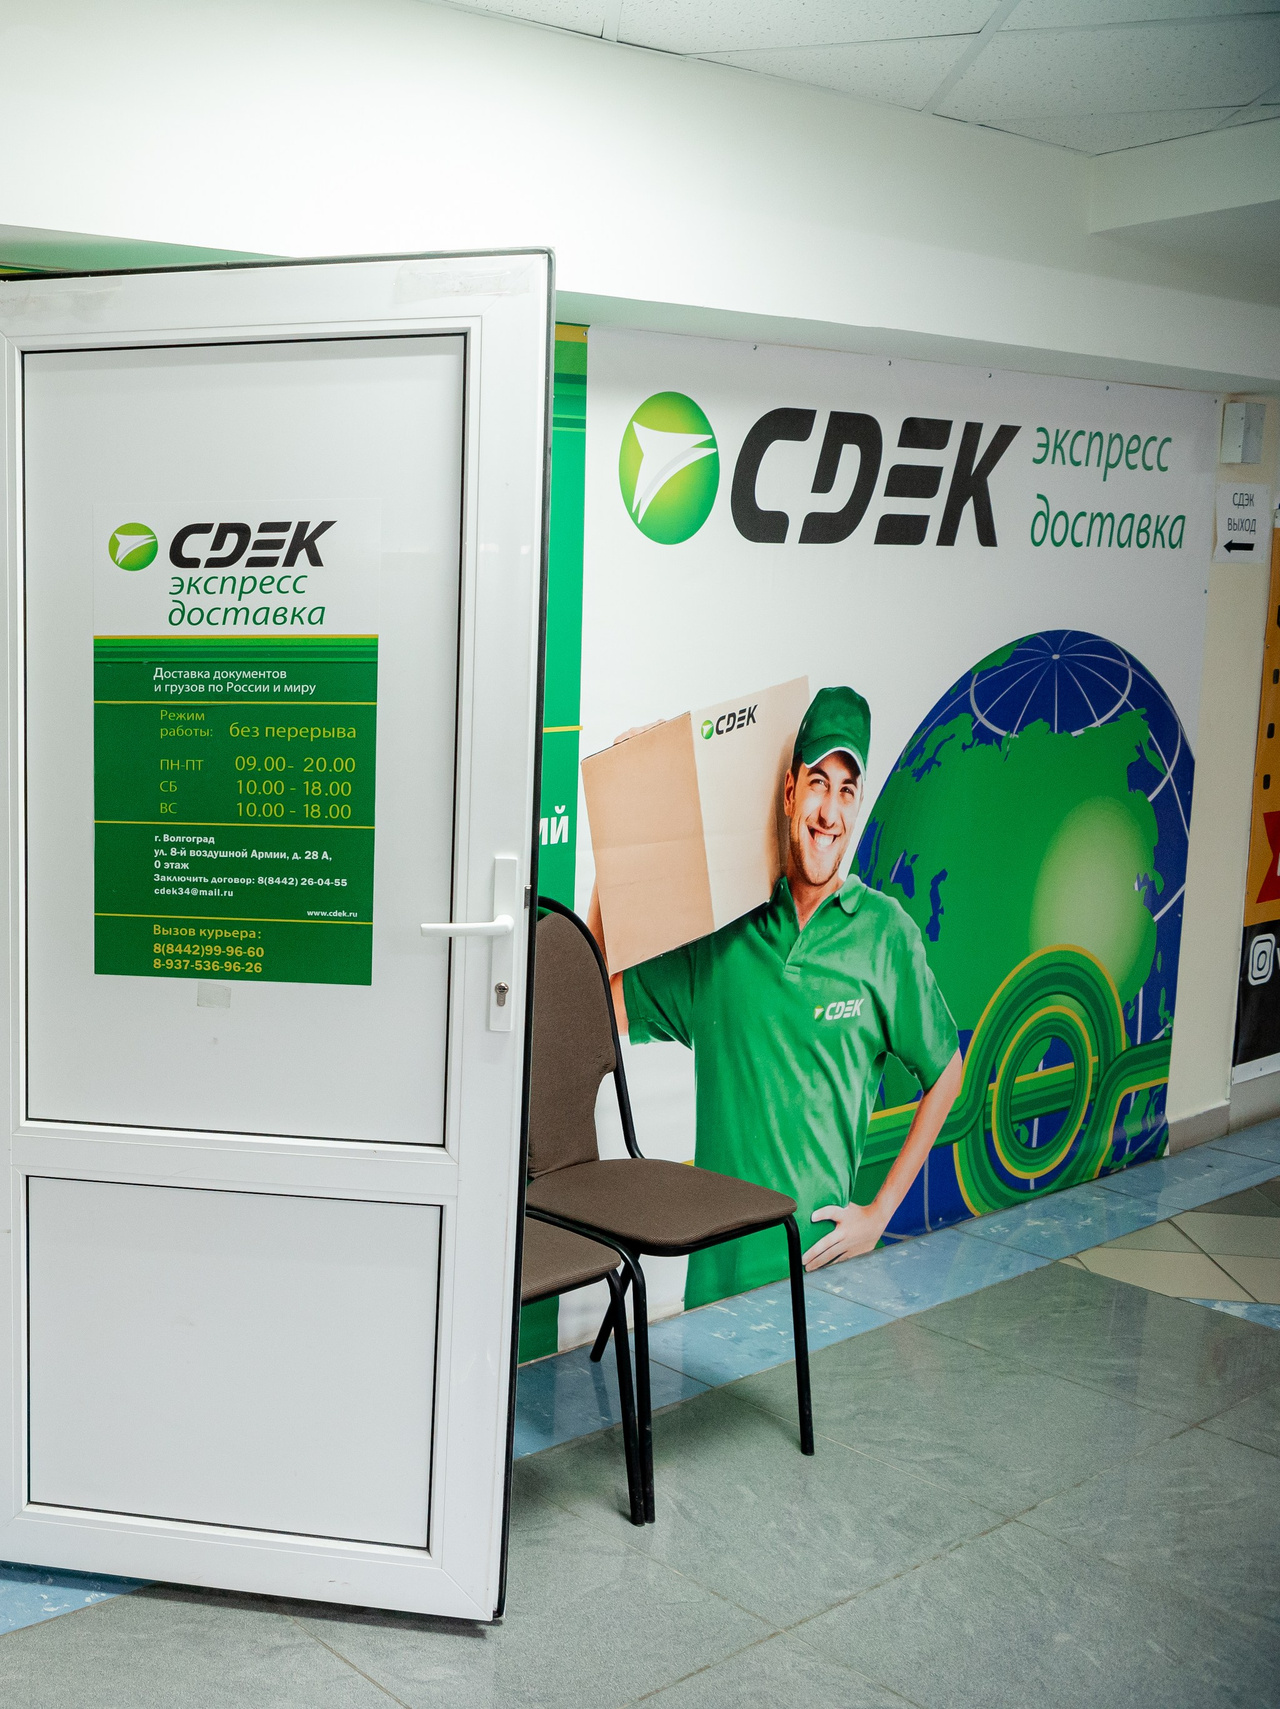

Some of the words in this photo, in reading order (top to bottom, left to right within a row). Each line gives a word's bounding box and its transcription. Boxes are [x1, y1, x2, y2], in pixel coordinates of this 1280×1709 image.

[1031, 424, 1173, 482] экспресс
[731, 406, 1022, 548] CDEK
[1232, 492, 1255, 510] СДЭК
[1030, 493, 1186, 550] доставка
[1227, 517, 1257, 535] ВЫХОД
[169, 520, 338, 569] CDEK
[169, 574, 308, 601] экспресс
[168, 600, 326, 626] доставка
[153, 668, 211, 681] Доставка
[213, 670, 287, 682] документов
[154, 684, 161, 692] и
[163, 684, 205, 695] грузов
[208, 684, 224, 692] по
[226, 682, 270, 693] России
[273, 684, 281, 693] и
[284, 684, 317, 695] миру
[160, 710, 205, 721] Режим
[715, 703, 759, 736] CDEK
[160, 725, 213, 739] работы:
[229, 722, 260, 738] без
[265, 725, 357, 741] перерыва
[160, 759, 204, 771] ПН-ПТ
[303, 757, 356, 773] 20.00
[159, 780, 177, 793] СБ
[236, 780, 284, 796] 10.00
[160, 802, 177, 814] ВС
[236, 802, 284, 818] 10.00
[163, 834, 215, 845] Волгоград
[154, 848, 168, 858] ул.
[170, 847, 187, 857] 8-й
[189, 849, 248, 860] воздушной
[250, 850, 290, 861] Армии,
[292, 852, 302, 861] д.
[304, 850, 318, 860] 28
[163, 862, 190, 870] этаж
[153, 874, 209, 884] Заключить
[211, 876, 255, 887] договор:
[300, 877, 348, 887] 26-04-55
[154, 886, 234, 897] cdek34@mail.ru
[306, 909, 358, 918] www.cdek.ru
[153, 924, 196, 937] Вызов
[199, 927, 261, 940] курьера:
[153, 943, 265, 958] 8(8442)99-96-60
[153, 959, 263, 973] 8-937-536-96-26
[825, 998, 865, 1021] CDEK
